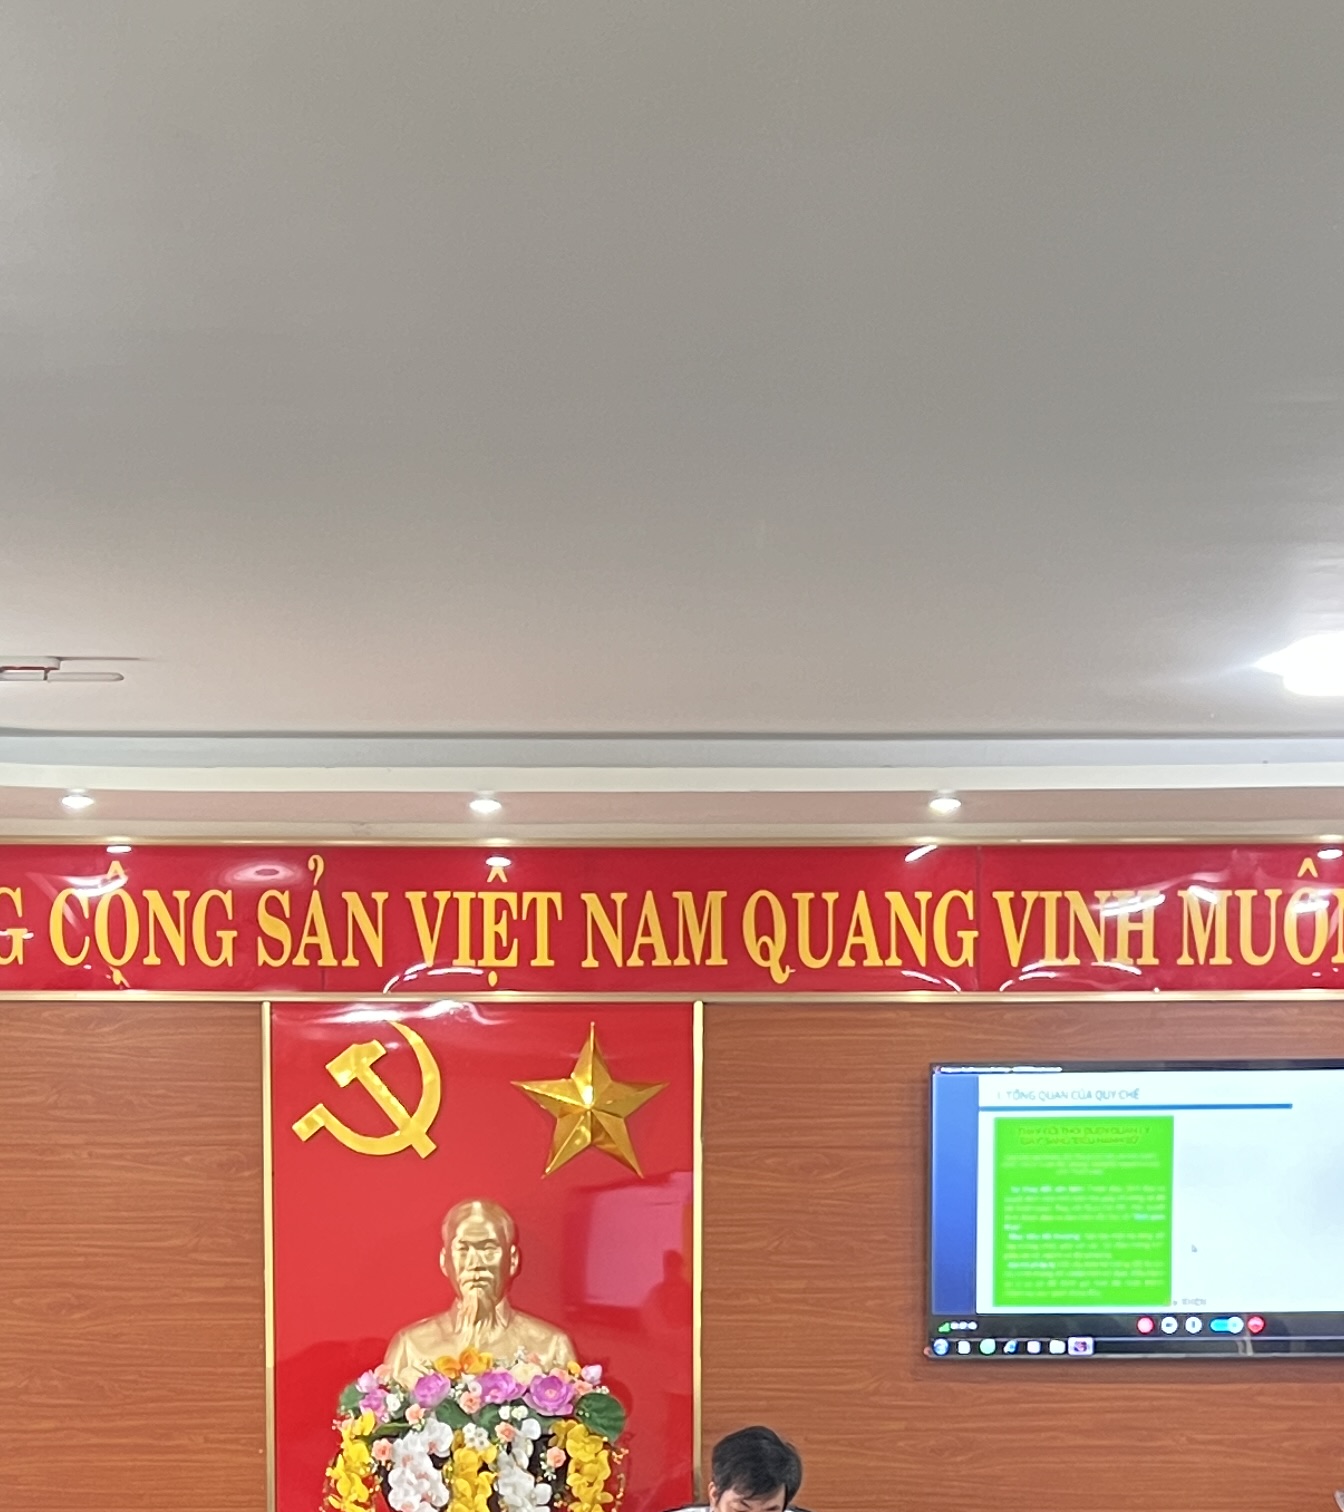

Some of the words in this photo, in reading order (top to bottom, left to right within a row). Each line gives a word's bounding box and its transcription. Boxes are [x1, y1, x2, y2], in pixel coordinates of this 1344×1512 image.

[49, 862, 239, 986] CỘNG
[257, 853, 390, 968] SẢN
[405, 863, 564, 987] VIỆT
[580, 890, 729, 968] NAM
[743, 889, 980, 984] QUANG
[992, 889, 1158, 968] VINH
[1038, 1090, 1069, 1102] QUAN
[1095, 1089, 1117, 1101] QUY
